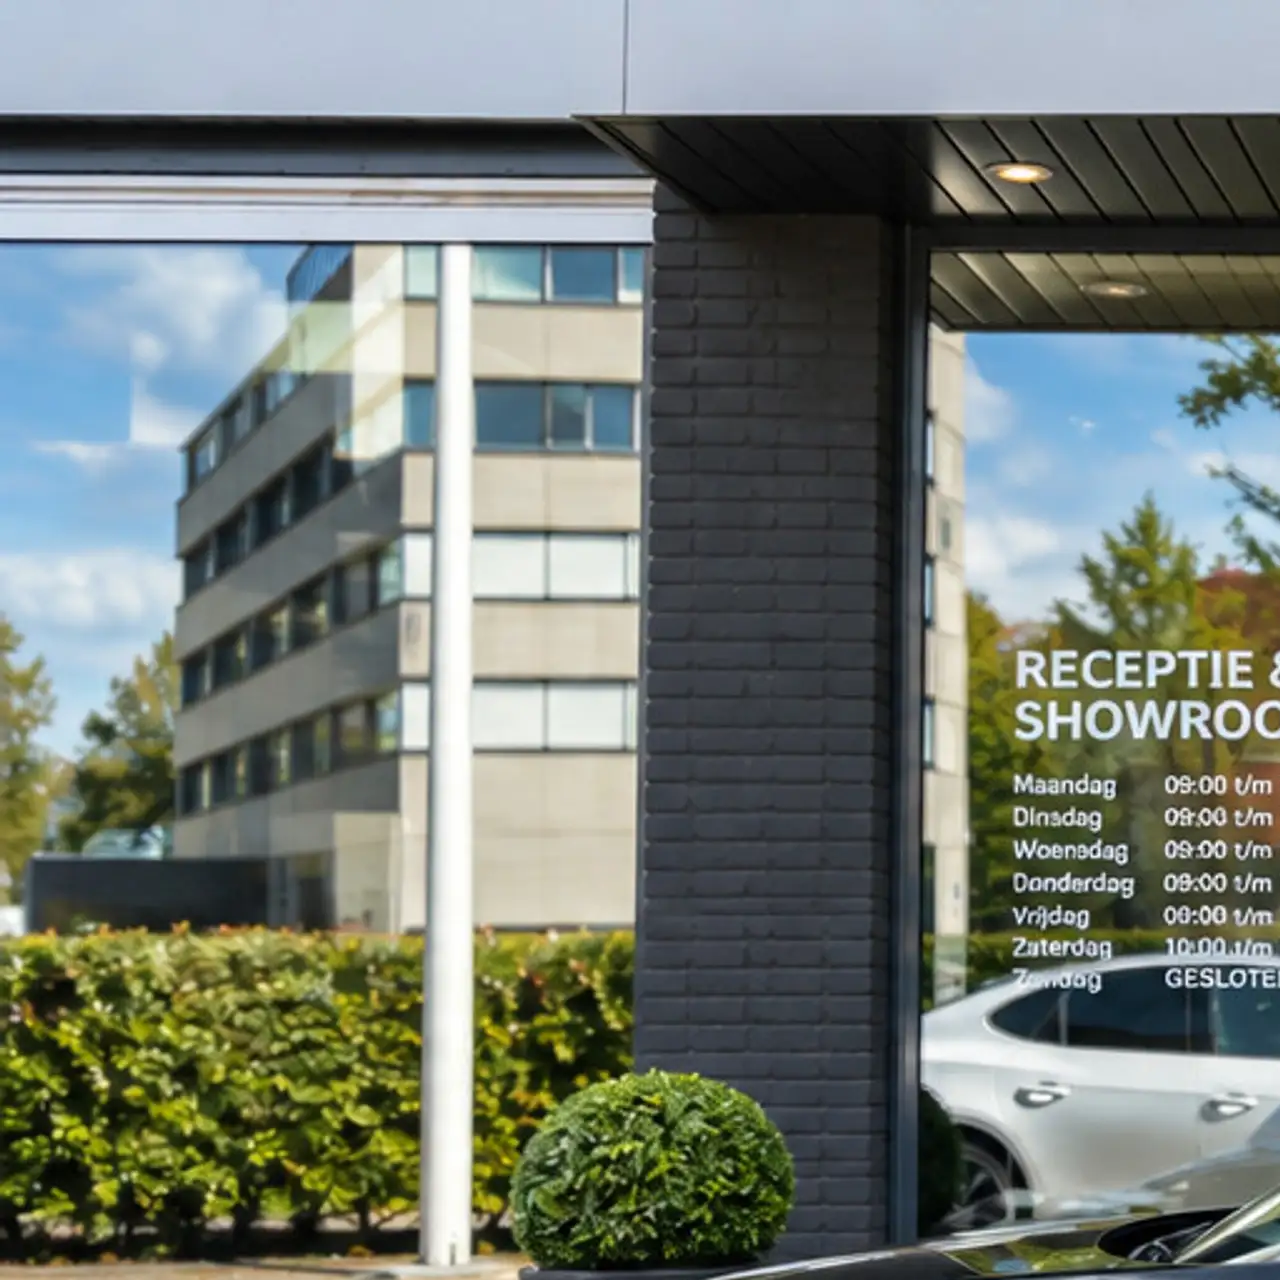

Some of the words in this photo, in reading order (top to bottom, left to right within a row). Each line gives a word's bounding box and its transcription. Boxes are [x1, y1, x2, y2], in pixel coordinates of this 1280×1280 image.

[1015, 649, 1254, 689] RECEPTIE
[1013, 773, 1117, 800] Maandag
[1233, 773, 1273, 796] t/m
[1013, 806, 1102, 832] Dinsdag
[1233, 806, 1273, 827] t/m
[1013, 839, 1129, 865] Woensdag
[1233, 840, 1273, 860] t/m
[1012, 872, 1135, 899] Donderdag
[1233, 872, 1273, 893] t/m
[1012, 905, 1090, 930] Vrijdag
[1233, 906, 1273, 926] t/m
[1233, 938, 1273, 957] t/m
